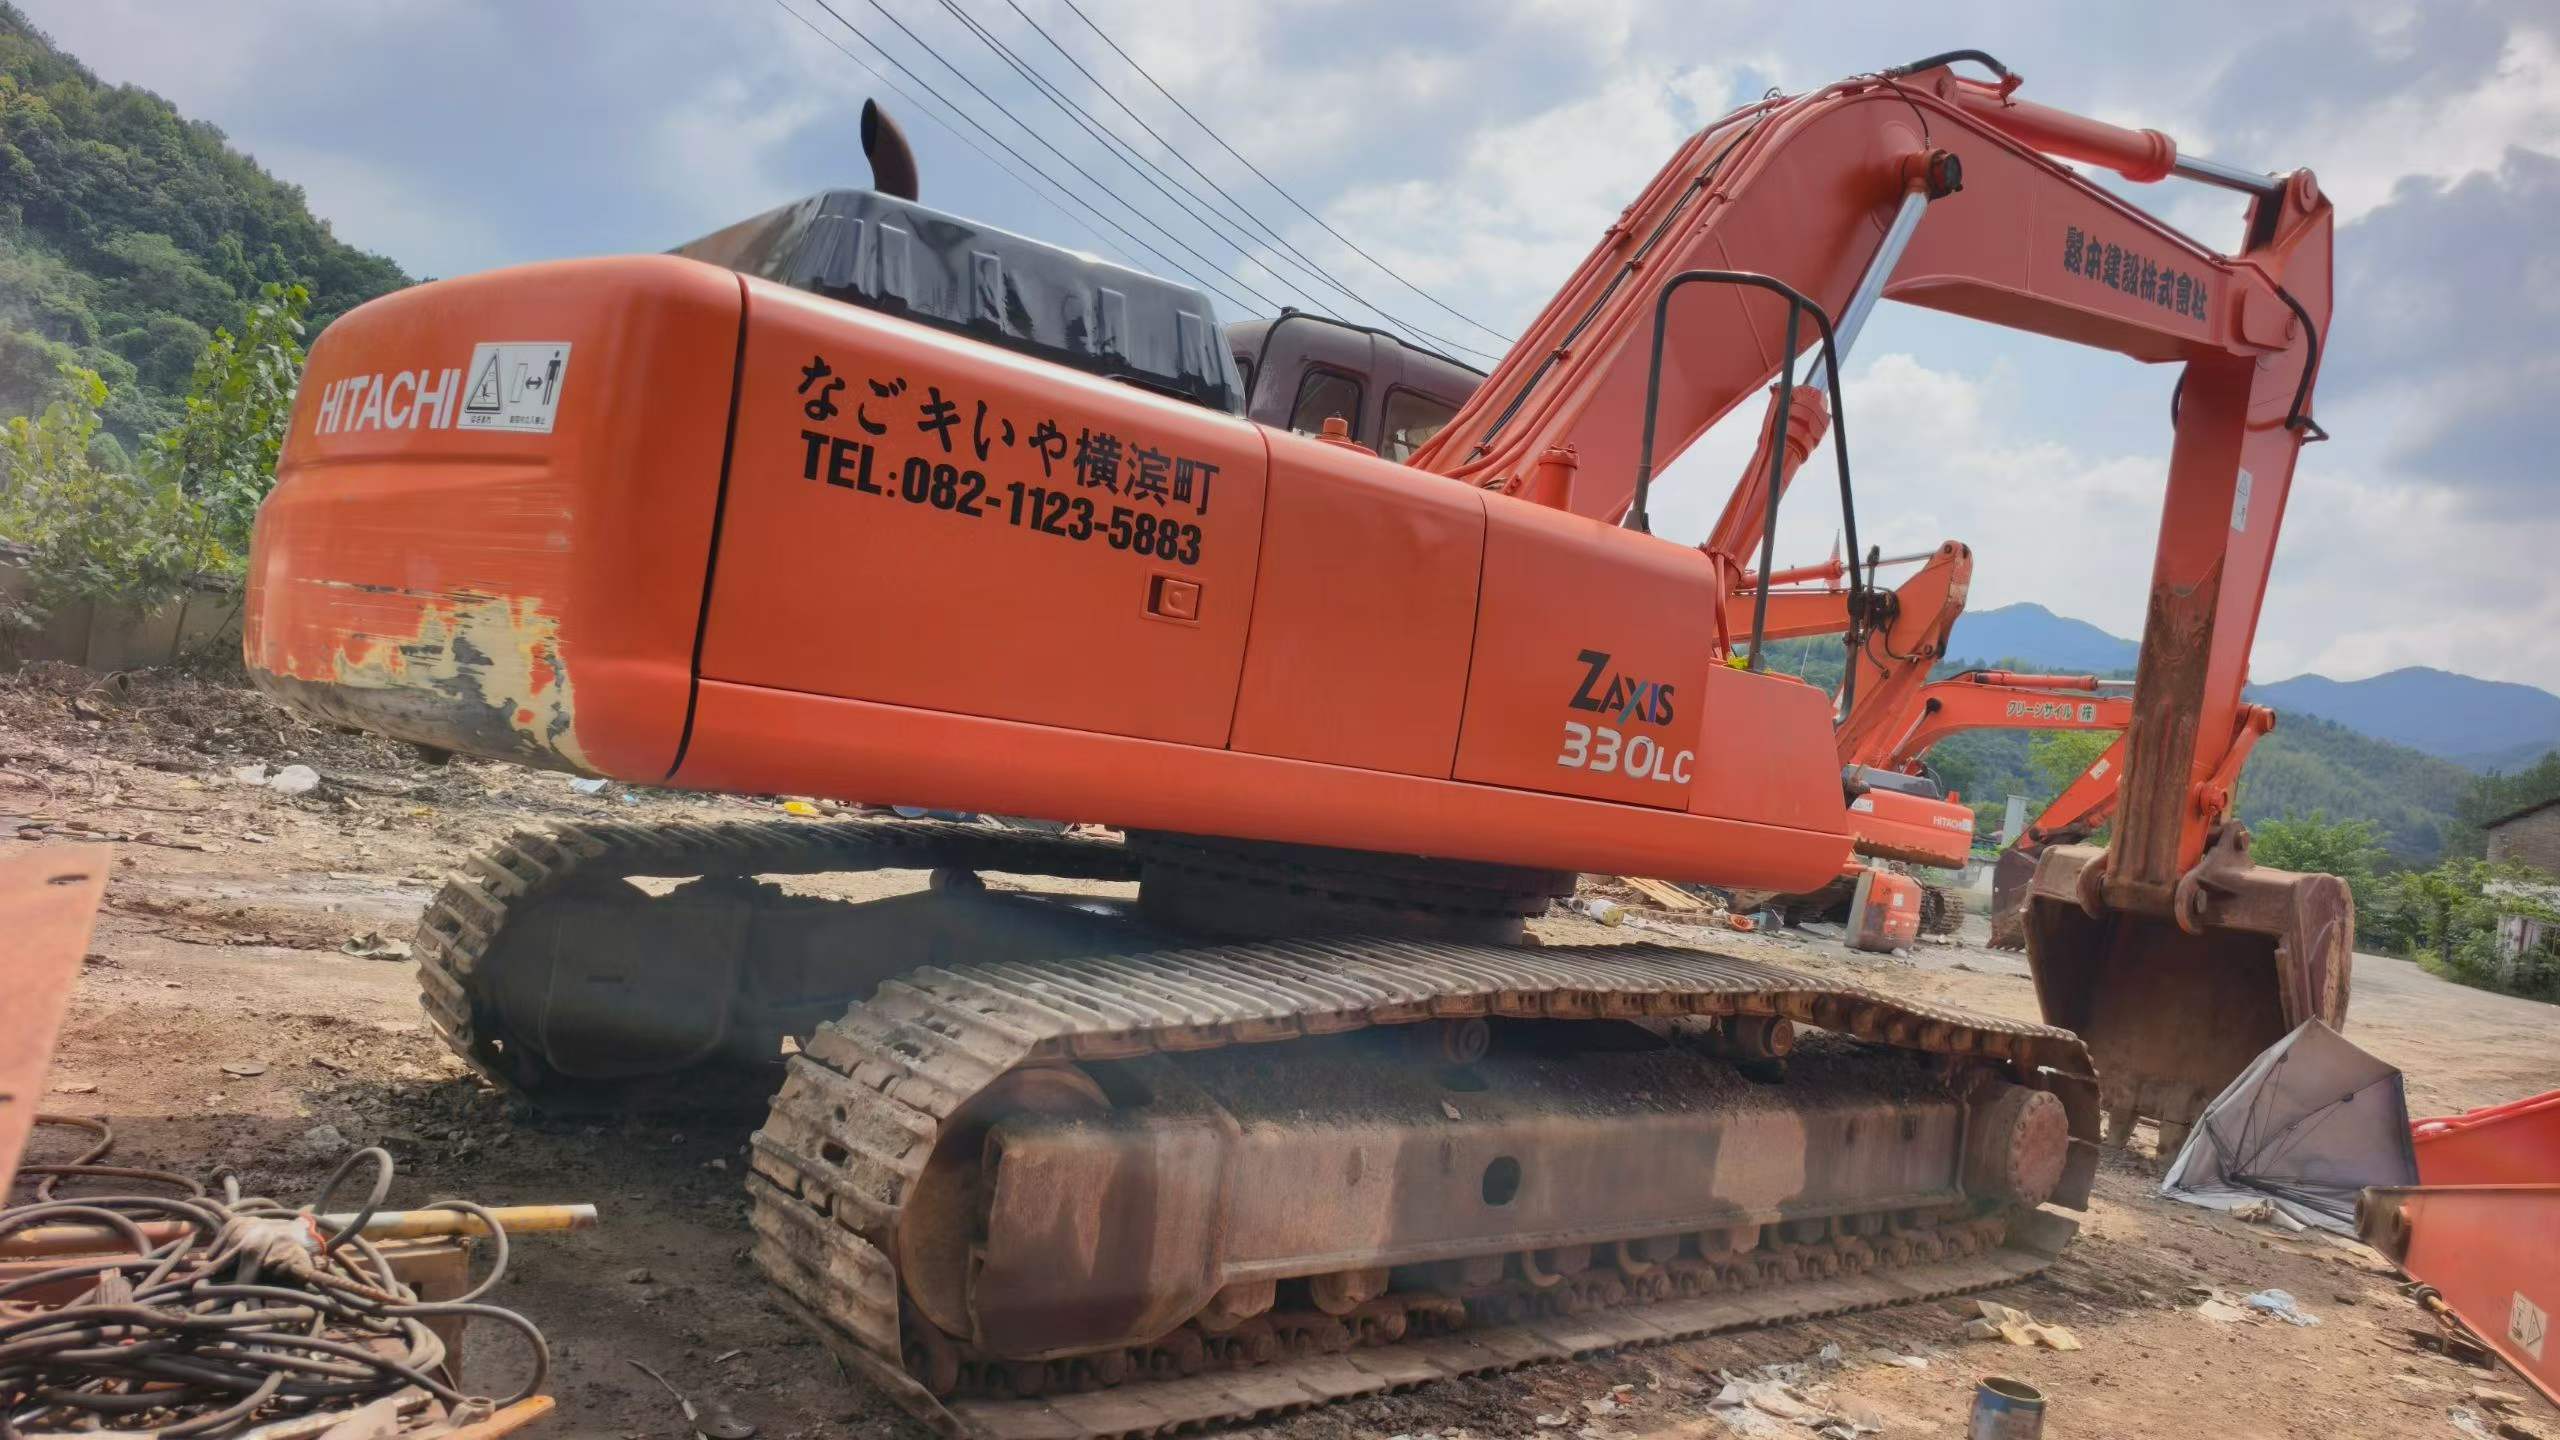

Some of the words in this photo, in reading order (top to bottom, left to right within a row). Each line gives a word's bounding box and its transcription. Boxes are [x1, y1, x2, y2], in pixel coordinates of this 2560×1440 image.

[315, 368, 461, 435] HITACHI
[800, 429, 1202, 566] TEL:082-1123-5883
[1568, 649, 1674, 726] ZAXIS
[1557, 720, 1695, 784] 330LC
